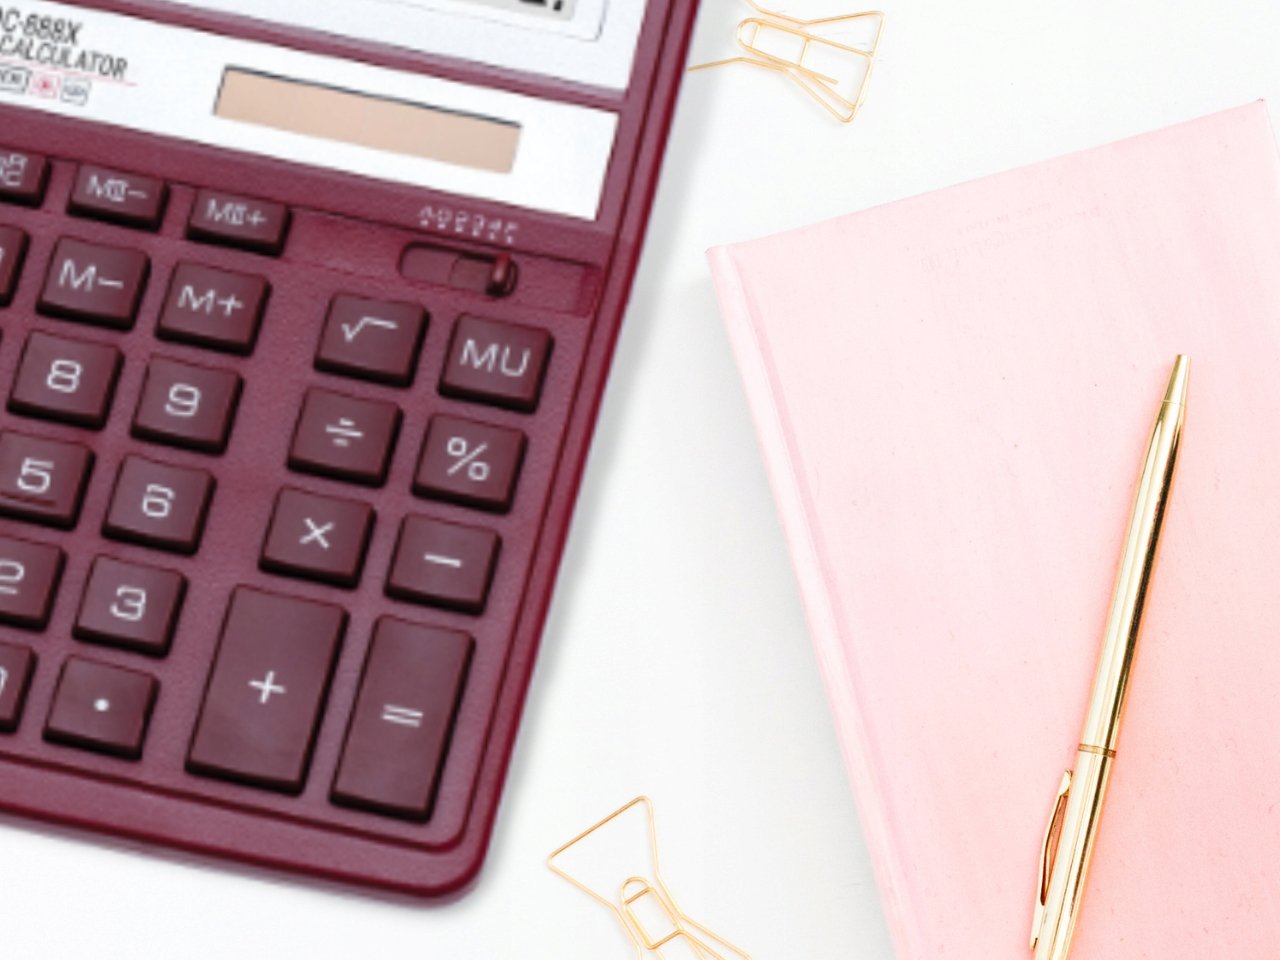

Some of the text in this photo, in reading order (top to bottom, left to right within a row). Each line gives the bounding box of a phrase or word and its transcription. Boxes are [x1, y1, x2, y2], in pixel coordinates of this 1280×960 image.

[0, 34, 128, 79] CALCULATOR
[177, 284, 243, 316] M+
[460, 338, 531, 377] MU
[45, 358, 84, 394] 8
[164, 383, 202, 418] 9
[16, 457, 54, 495] 5
[446, 436, 491, 482] %
[141, 483, 176, 519] 6
[109, 585, 147, 622] 3
[248, 670, 286, 704] +
[381, 704, 424, 728] =
